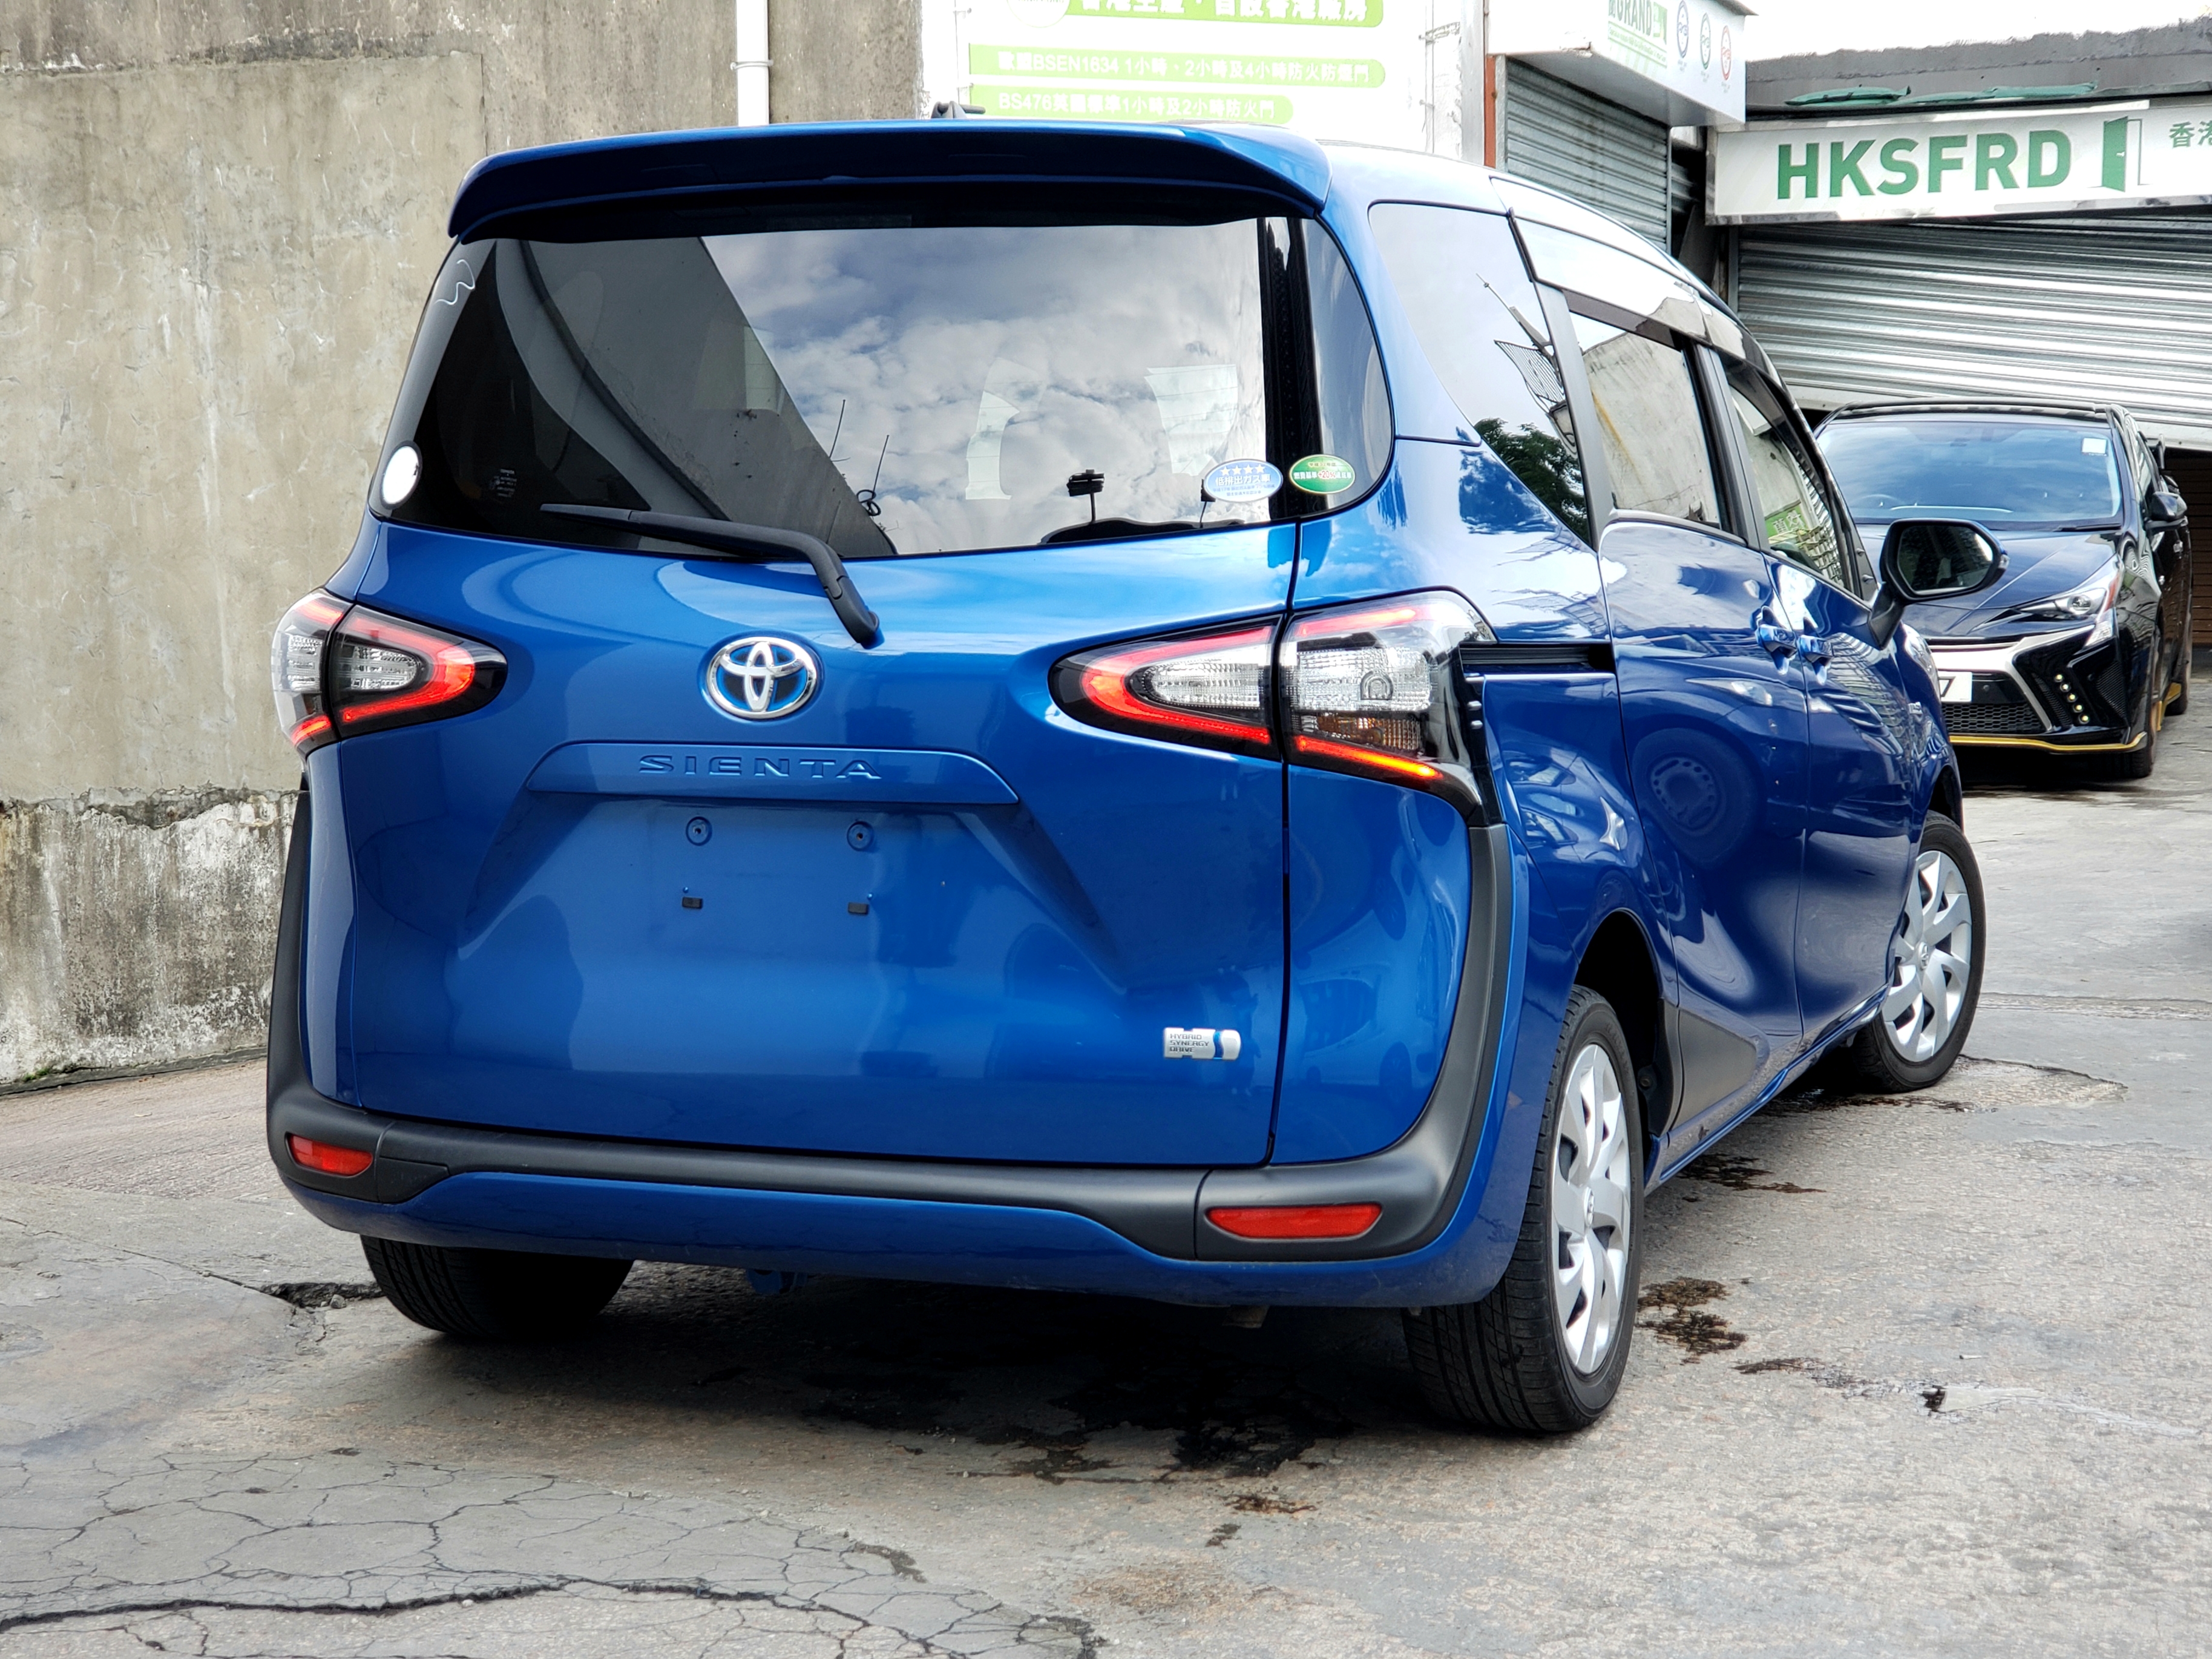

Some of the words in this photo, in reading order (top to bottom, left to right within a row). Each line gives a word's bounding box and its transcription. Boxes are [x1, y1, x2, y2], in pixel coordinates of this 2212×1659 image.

[1777, 129, 2070, 199] HKSFRD
[1215, 473, 1270, 487] 低排出ガス車
[639, 754, 881, 779] SIENTA
